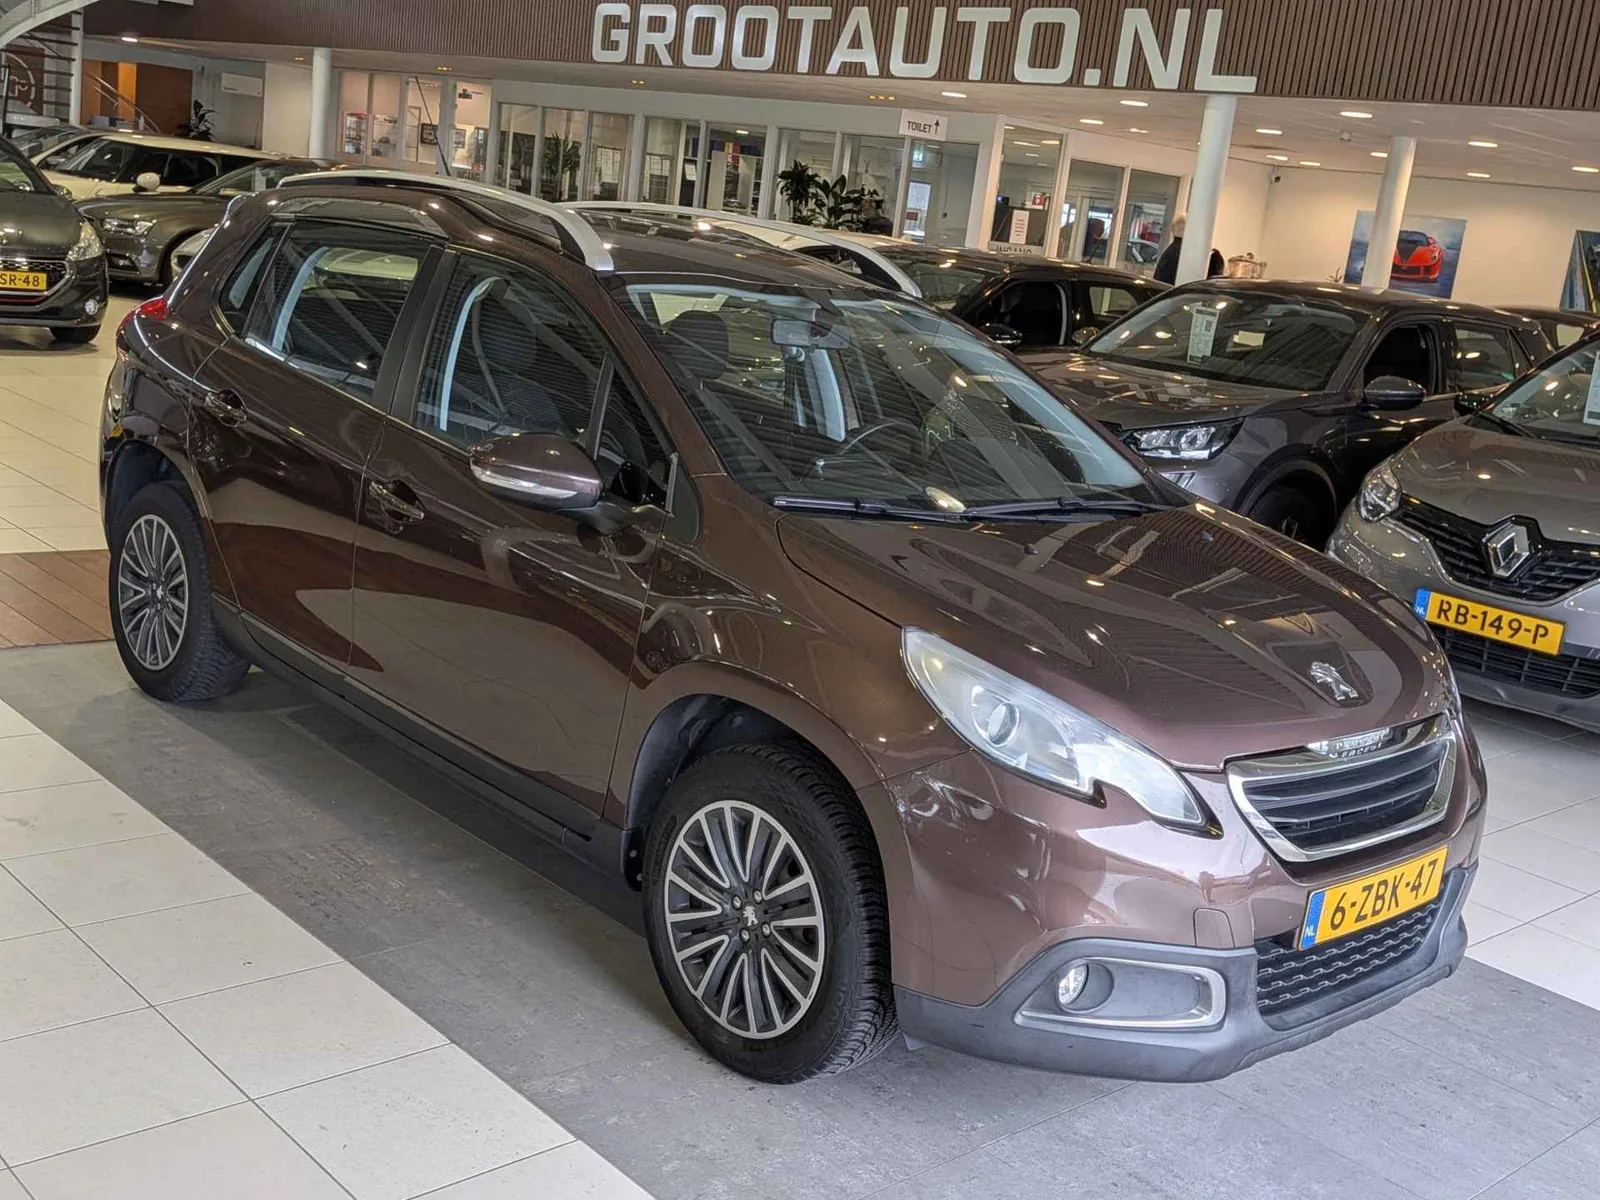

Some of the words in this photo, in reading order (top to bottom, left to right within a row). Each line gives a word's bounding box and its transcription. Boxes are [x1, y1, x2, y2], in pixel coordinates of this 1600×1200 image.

[591, 2, 1257, 92] GROOTAUTO.NL
[907, 120, 932, 133] TOILET
[1437, 599, 1549, 645] RB-149-P
[1330, 858, 1439, 931] 6-ZBK-47
